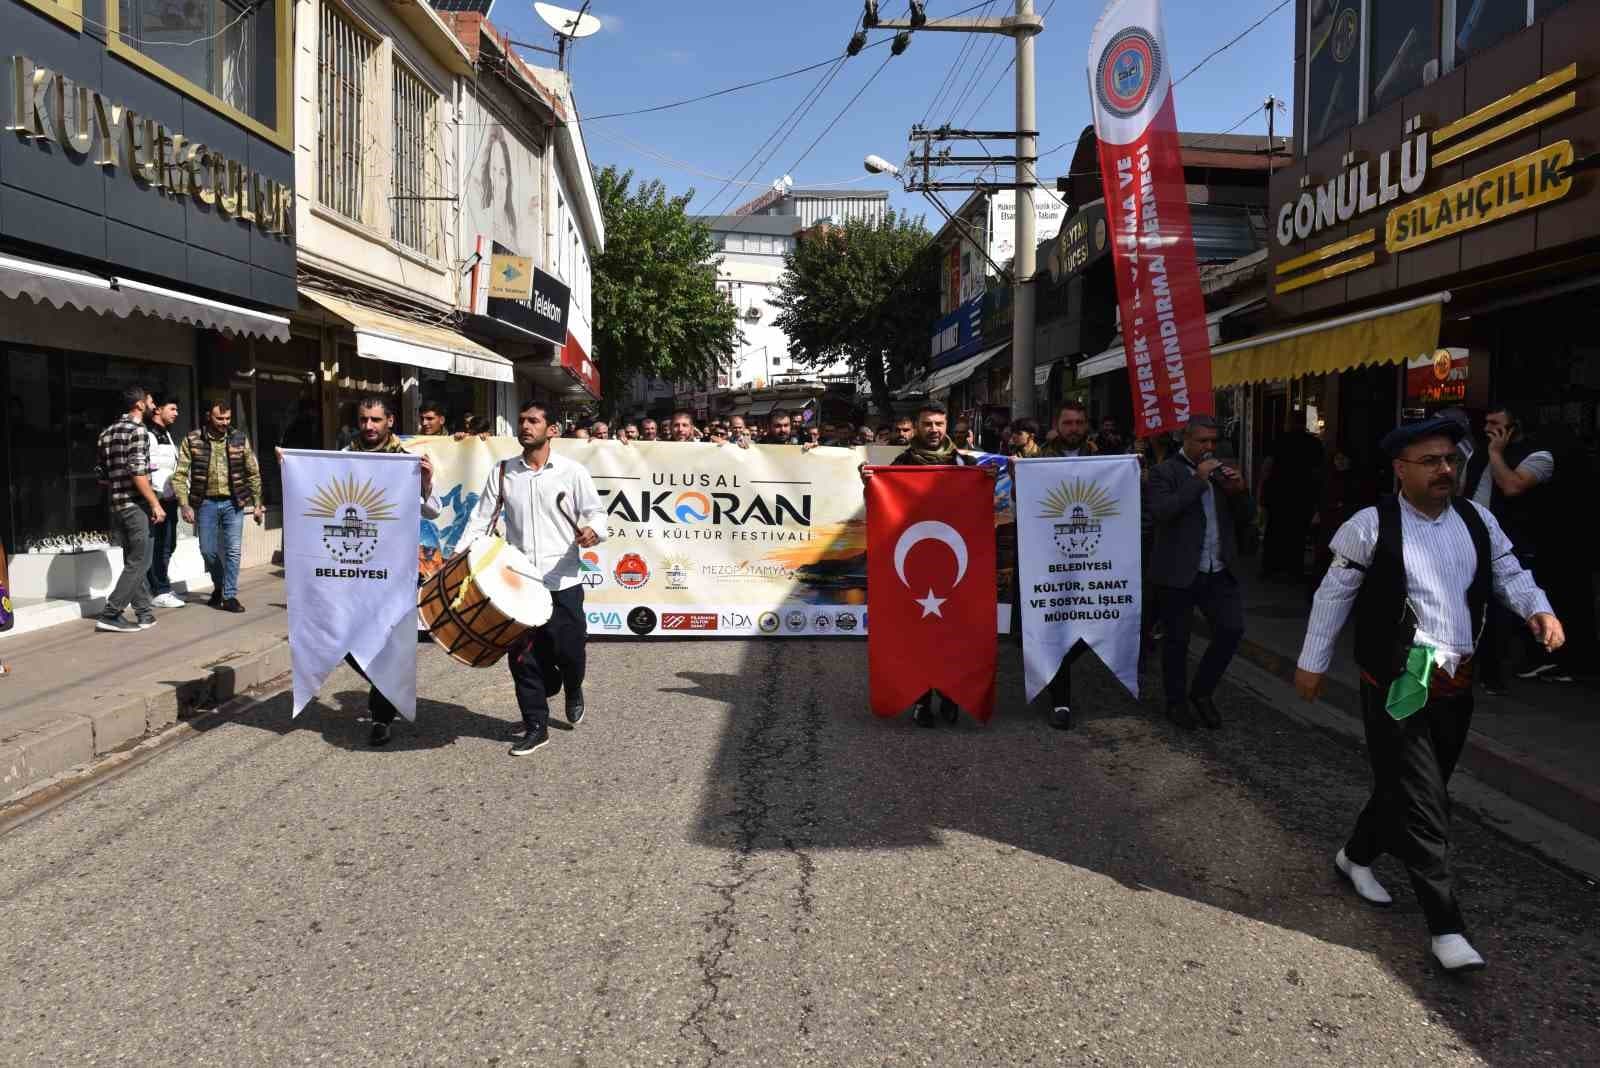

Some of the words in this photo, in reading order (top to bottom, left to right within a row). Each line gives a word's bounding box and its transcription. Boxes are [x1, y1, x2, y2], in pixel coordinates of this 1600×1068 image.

[1117, 156, 1134, 189] VE
[1276, 113, 1428, 246] GÖNÜLLÜ
[1137, 144, 1163, 248] DERNEĞİ
[1395, 153, 1564, 241] SİLAHÇILIK
[534, 289, 561, 323] Telekom
[1148, 256, 1190, 422] KALKINDIRMA
[652, 472, 741, 488] ULUSAL
[607, 527, 626, 537] ĞA
[636, 529, 654, 538] VE
[663, 527, 723, 540] KÜLTÜR
[731, 528, 812, 541] FESTİVALİ
[315, 567, 388, 580] BELEDİYESİ
[1048, 560, 1112, 573] BELEDİYESİ
[1033, 580, 1085, 593] KÜLTÜR,
[1087, 579, 1129, 591] SANAT
[1029, 599, 1046, 608] VE
[1050, 596, 1095, 607] SOSYAL
[1097, 594, 1134, 608] İŞLER
[1044, 610, 1120, 623] MÜDÜRLÜĞÜ
